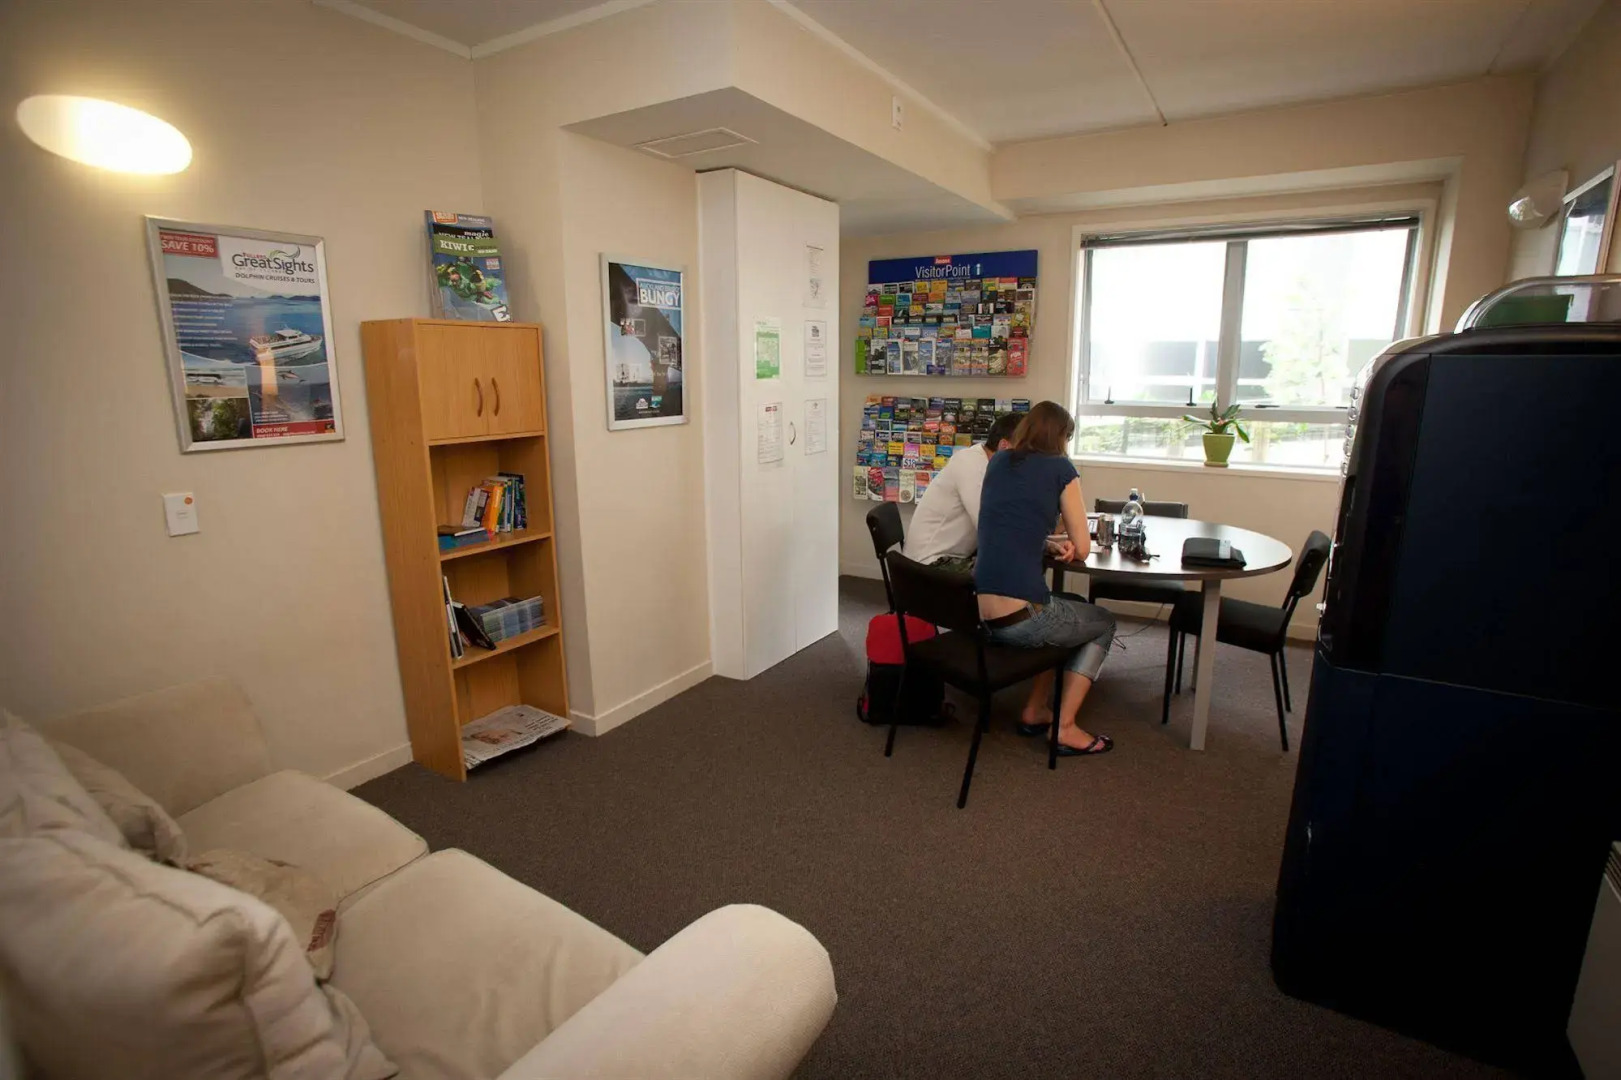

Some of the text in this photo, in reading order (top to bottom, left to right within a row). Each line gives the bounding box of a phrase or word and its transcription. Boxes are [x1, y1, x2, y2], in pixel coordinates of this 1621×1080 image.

[161, 240, 190, 251] SAVE
[192, 243, 215, 253] 10%
[232, 253, 315, 275] GreatSights
[235, 272, 265, 280] DOLPHIN
[640, 288, 680, 307] BUNGY
